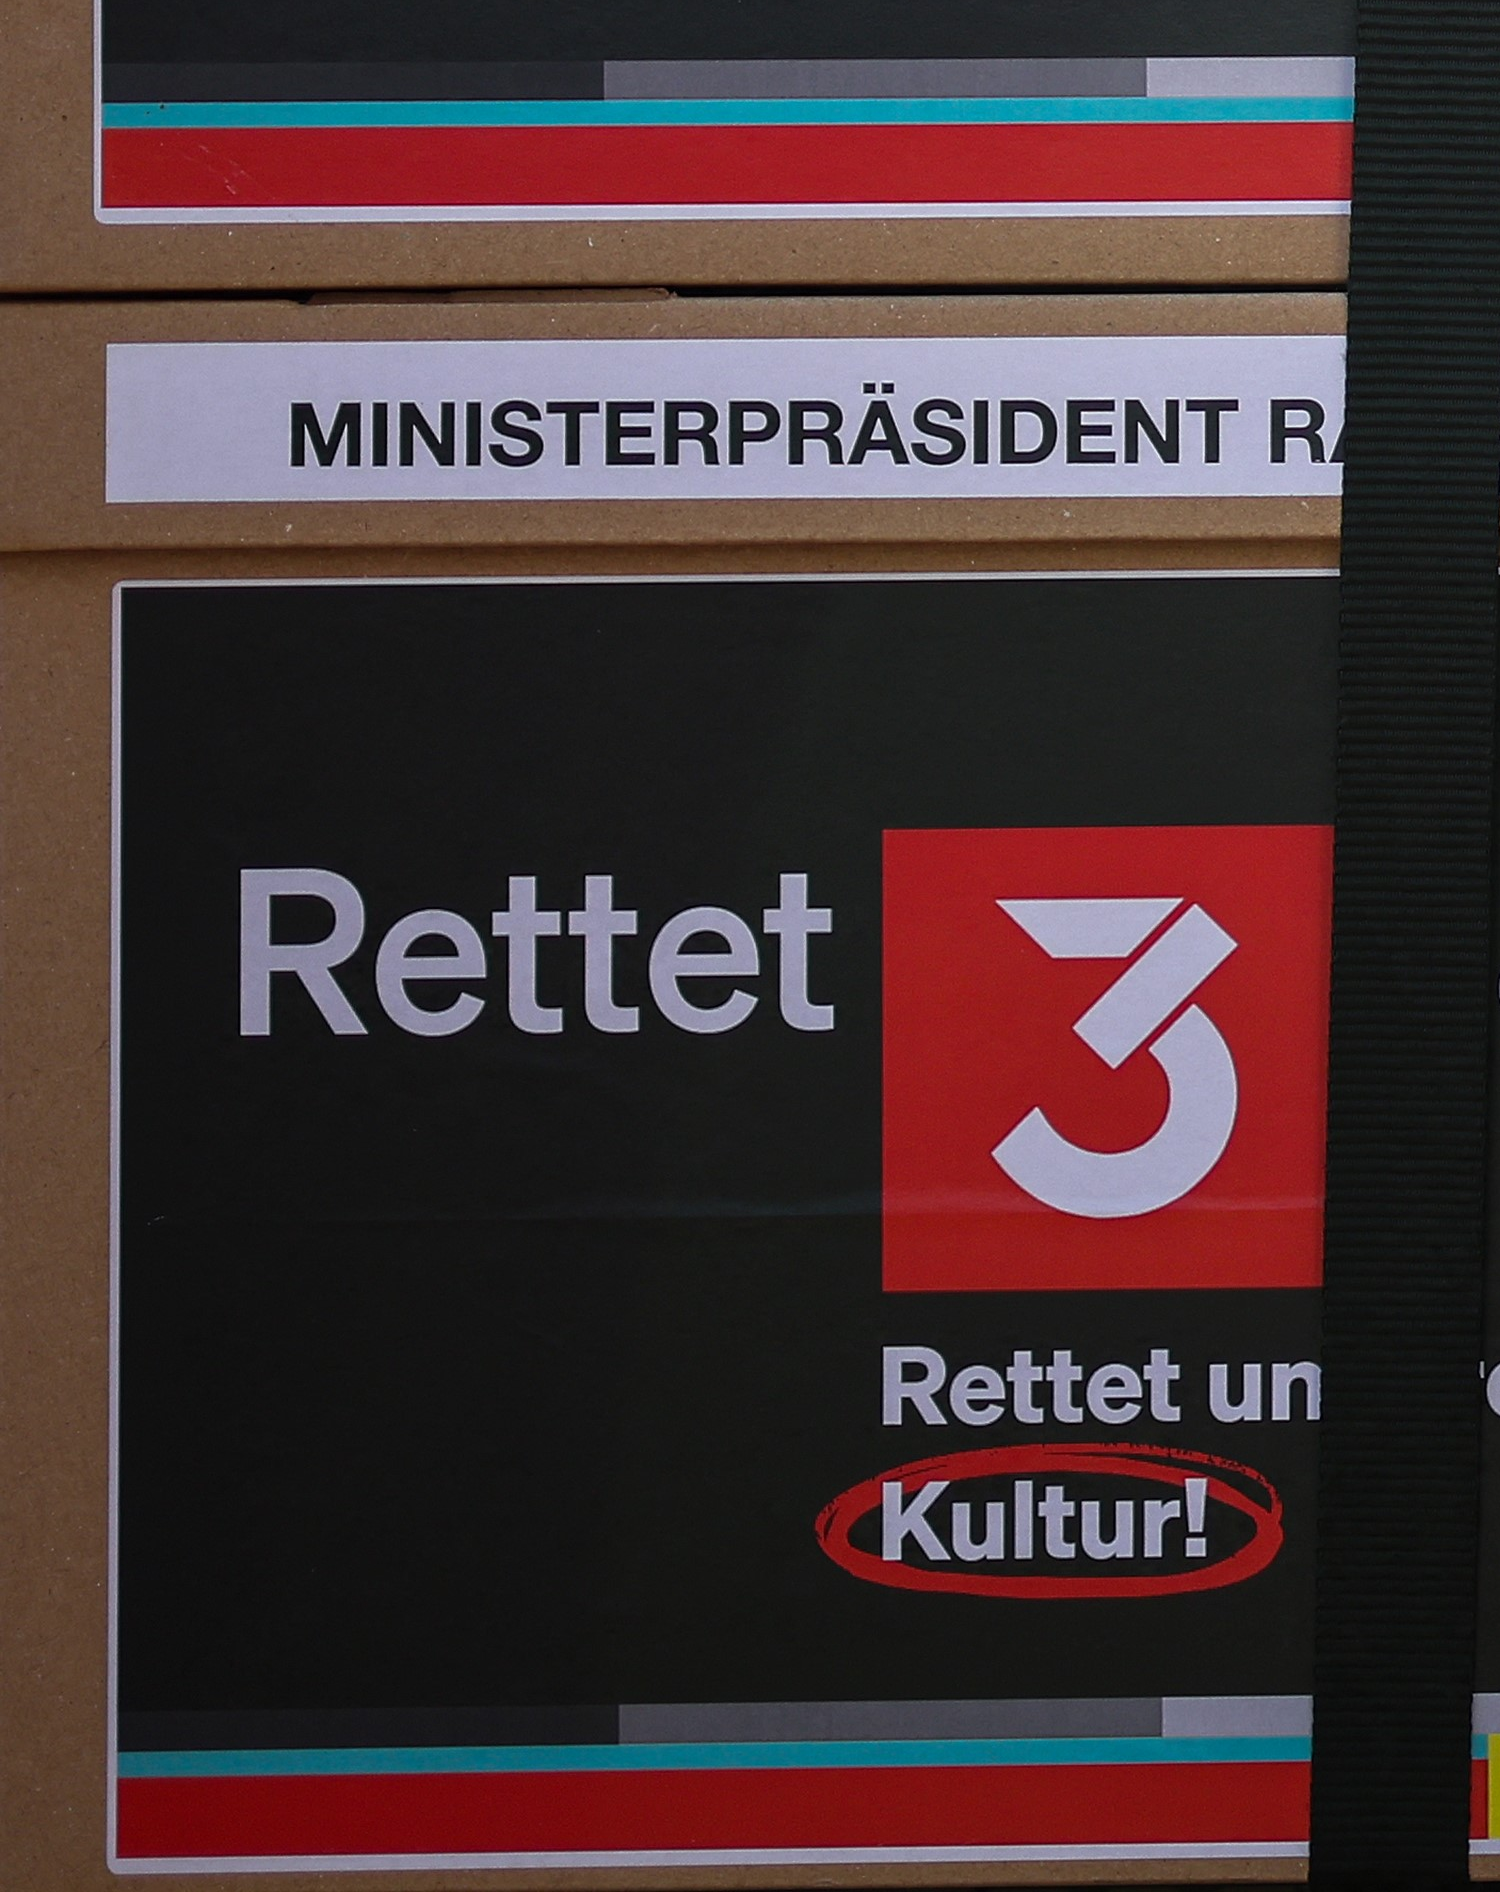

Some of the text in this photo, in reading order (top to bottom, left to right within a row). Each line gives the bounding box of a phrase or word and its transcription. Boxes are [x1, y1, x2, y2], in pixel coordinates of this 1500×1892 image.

[289, 381, 1240, 469] MINISTERPRÄSIDENT
[238, 867, 836, 1038] Rettet
[990, 896, 1240, 1220] 3
[881, 1345, 1182, 1427] Rettet
[881, 1476, 1209, 1563] Kultur!
